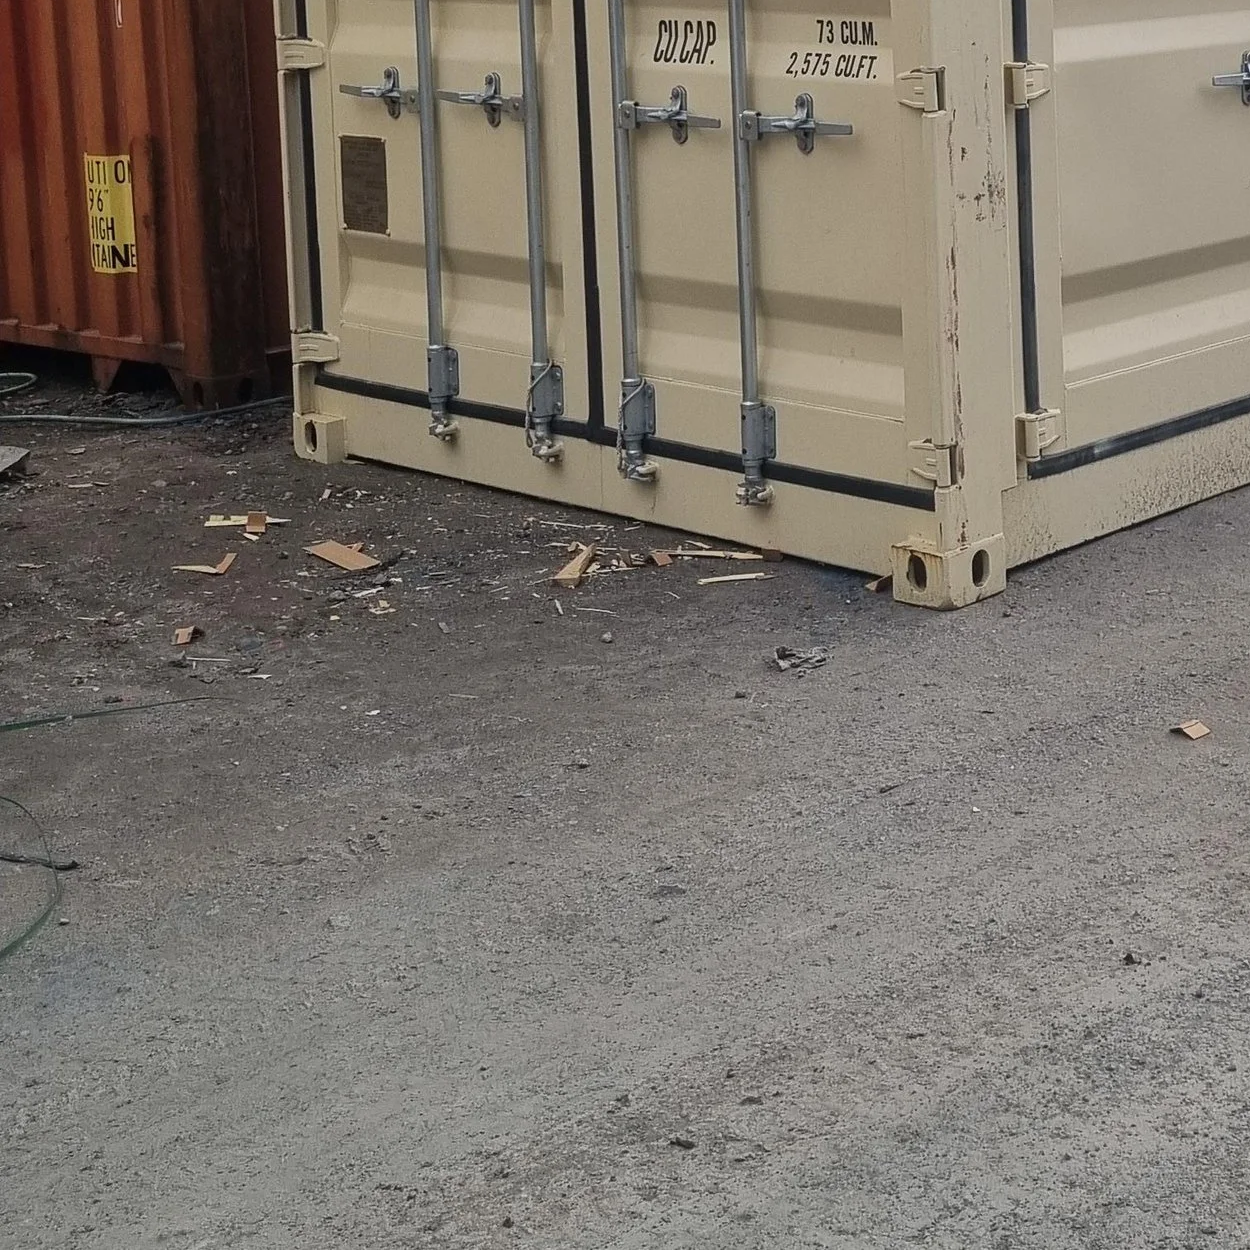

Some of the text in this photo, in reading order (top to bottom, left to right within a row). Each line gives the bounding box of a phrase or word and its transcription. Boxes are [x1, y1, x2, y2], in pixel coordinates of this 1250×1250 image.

[653, 19, 878, 65] CU.CAP. 73 CU.M.
[786, 52, 877, 79] 2,575 CU.FT.
